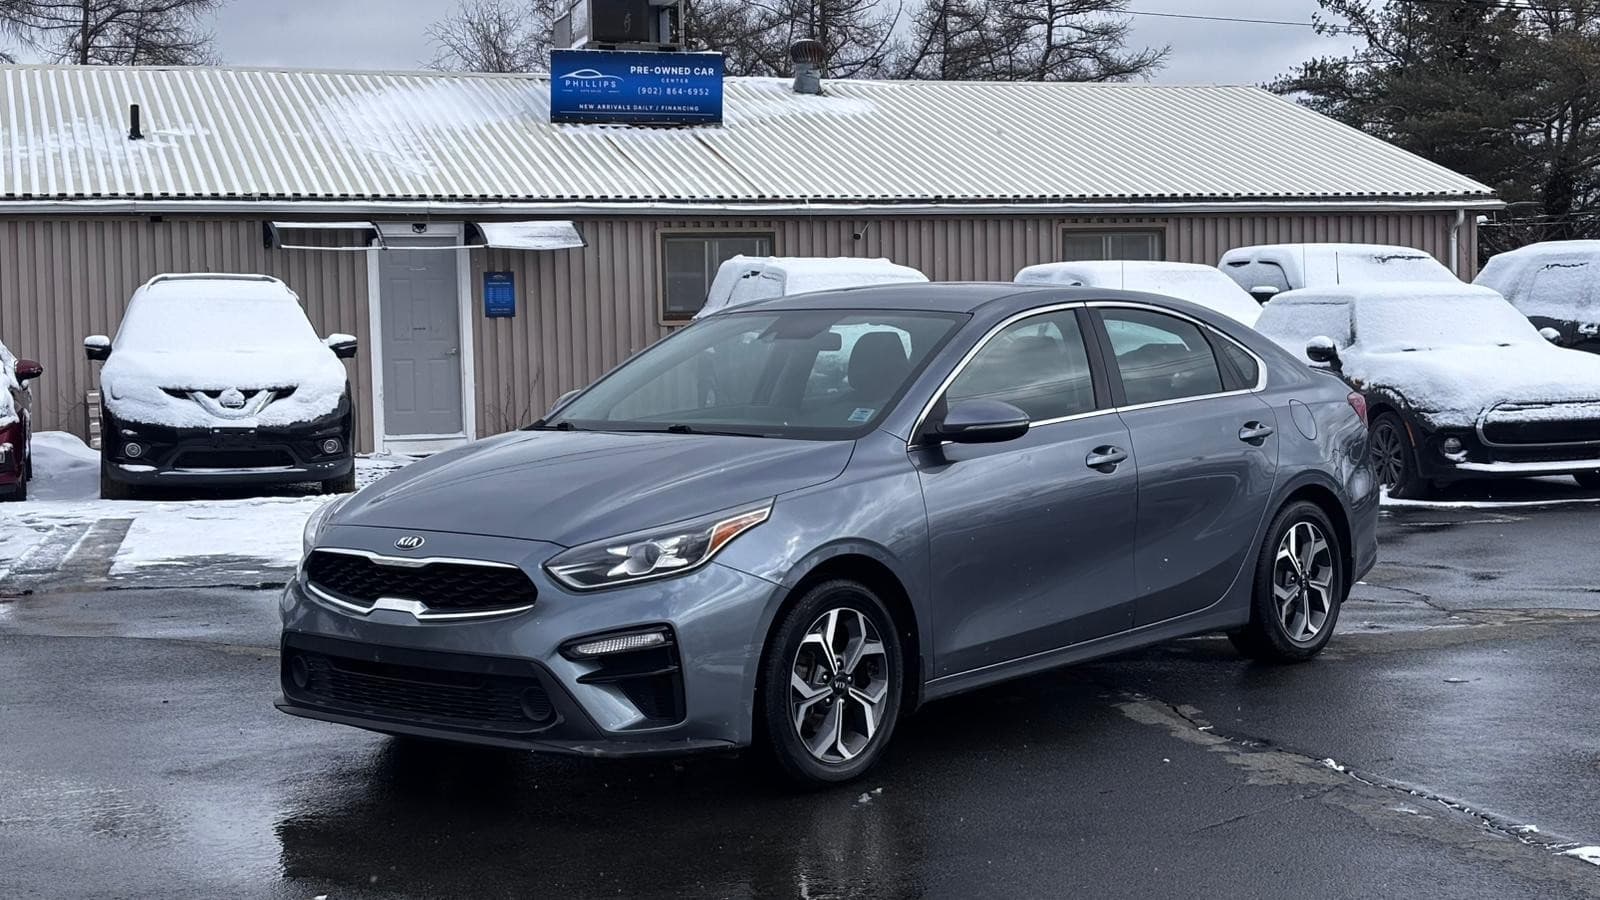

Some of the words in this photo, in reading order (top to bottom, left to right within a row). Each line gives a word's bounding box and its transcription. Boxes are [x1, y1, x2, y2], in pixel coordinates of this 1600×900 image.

[630, 66, 691, 76] PRE-OWNED
[693, 67, 715, 76] CAR
[565, 80, 617, 88] PHILLIPS
[637, 87, 662, 96] (902)
[666, 87, 710, 96] 864-6952
[397, 536, 419, 547] KIA
